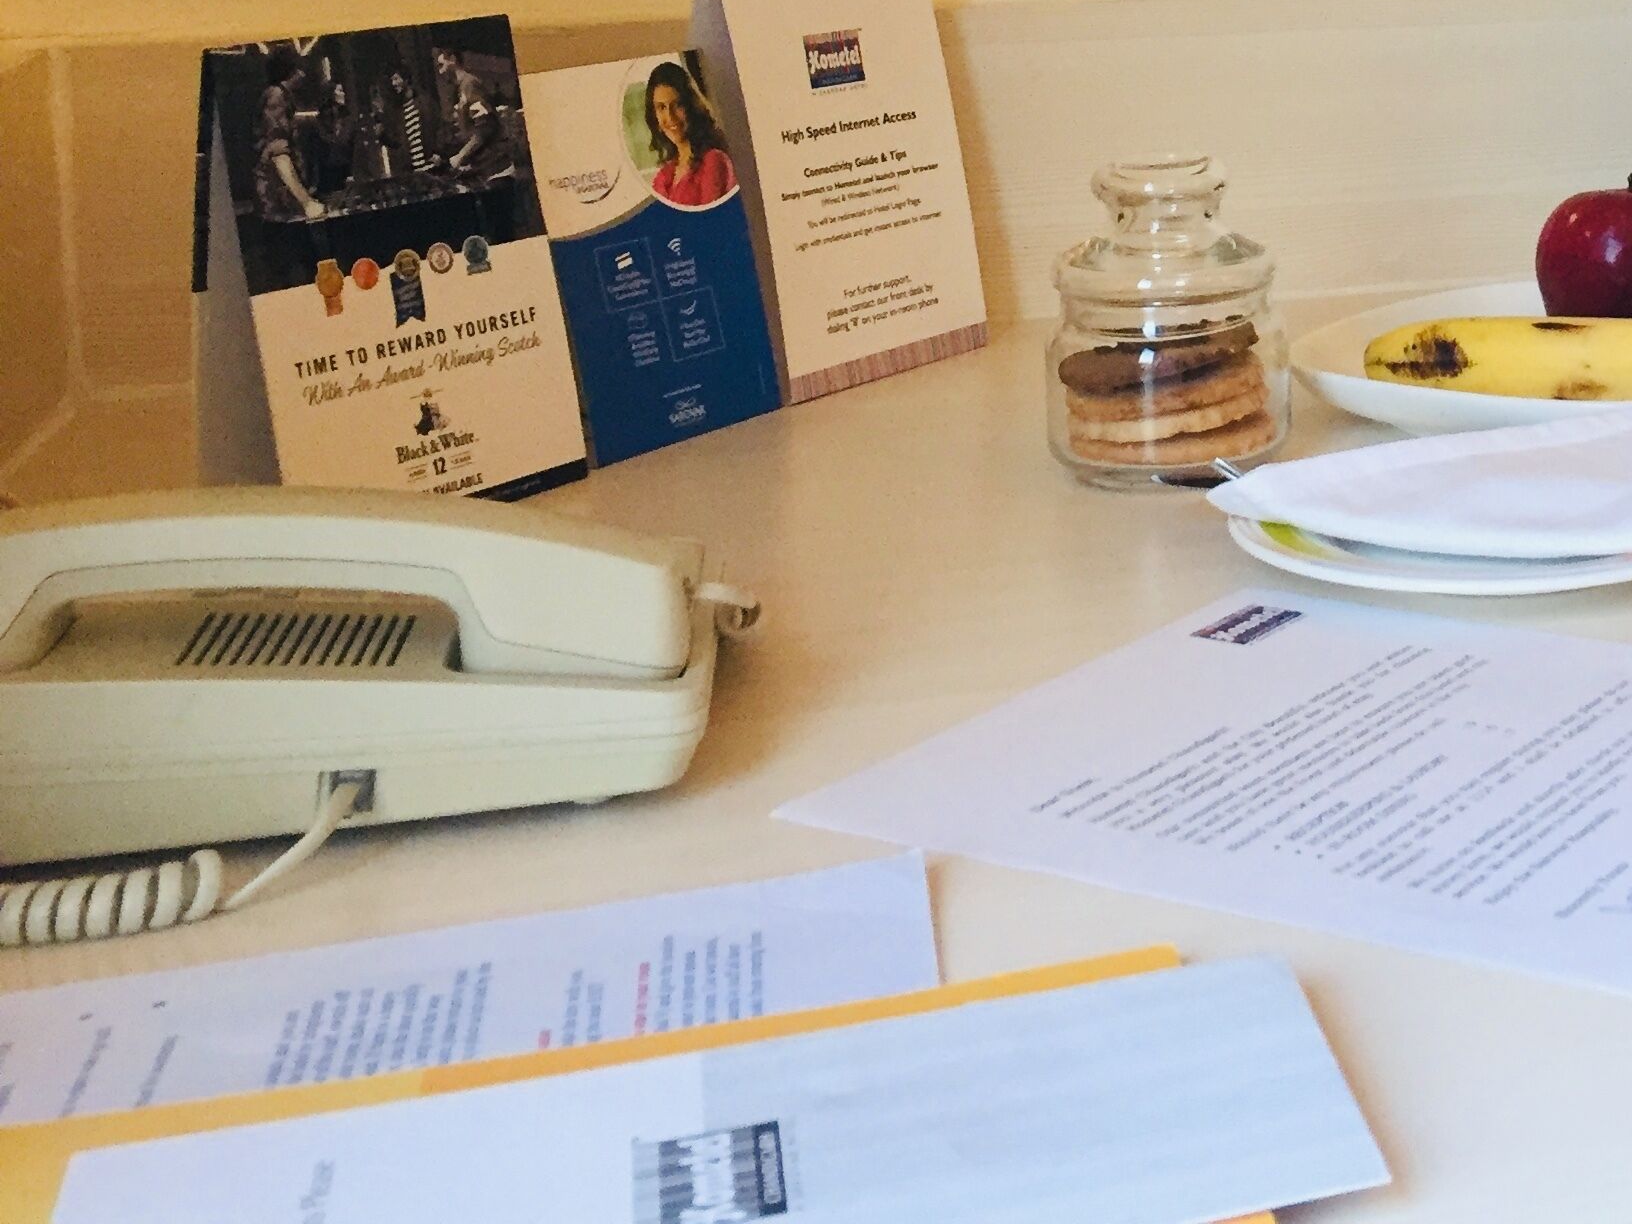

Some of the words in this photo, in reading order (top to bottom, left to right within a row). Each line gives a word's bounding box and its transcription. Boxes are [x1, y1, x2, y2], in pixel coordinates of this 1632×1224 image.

[780, 128, 805, 145] High
[806, 122, 837, 141] Speed
[839, 116, 880, 132] Internet
[882, 110, 917, 125] Access
[803, 160, 853, 178] Connectivity
[854, 154, 879, 167] Guide
[880, 152, 887, 163] &
[889, 149, 907, 162] Tips
[294, 353, 338, 379] TIME
[345, 347, 368, 367] TO
[375, 327, 447, 360] REWARD
[453, 306, 537, 341] YOURSELF
[302, 379, 344, 407] With
[347, 373, 373, 396] An
[498, 330, 543, 358] Scotch
[432, 456, 447, 476] 12
